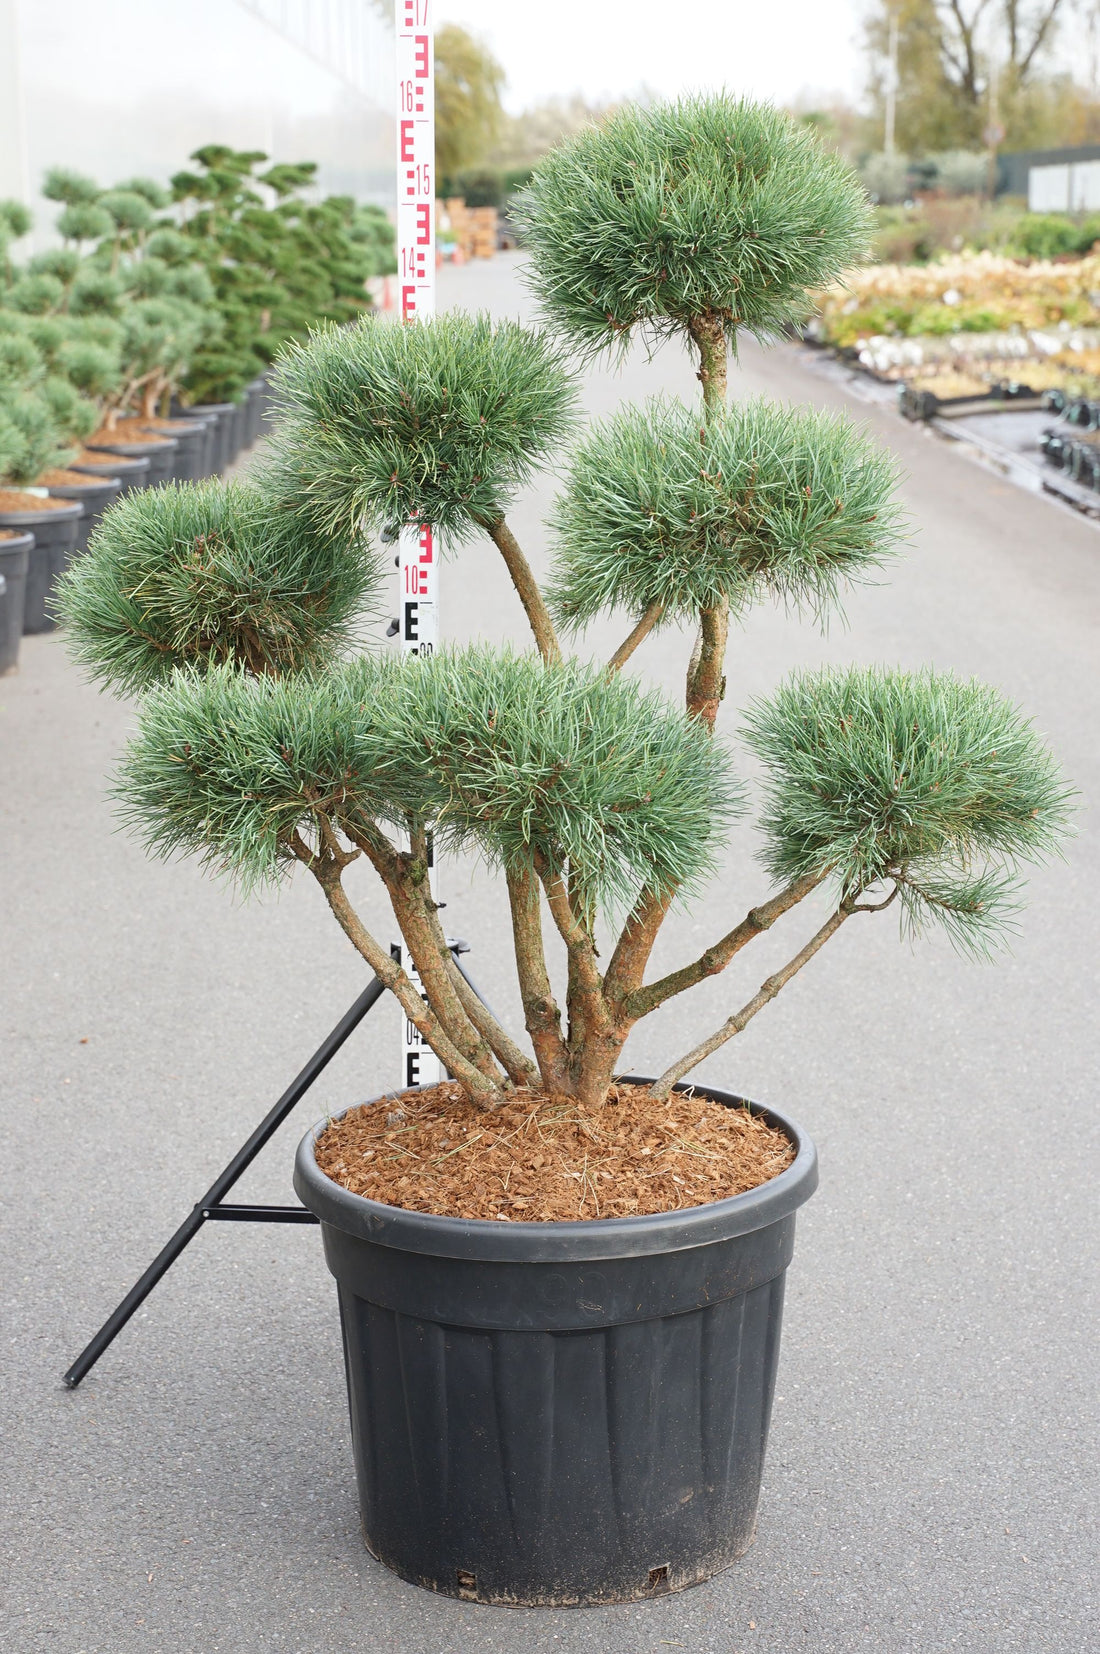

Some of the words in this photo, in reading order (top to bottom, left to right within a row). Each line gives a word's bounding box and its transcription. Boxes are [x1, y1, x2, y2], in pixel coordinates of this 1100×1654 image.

[400, 80, 413, 112] 16
[416, 164, 430, 196] 15
[402, 247, 416, 278] 14
[404, 565, 418, 594] 10
